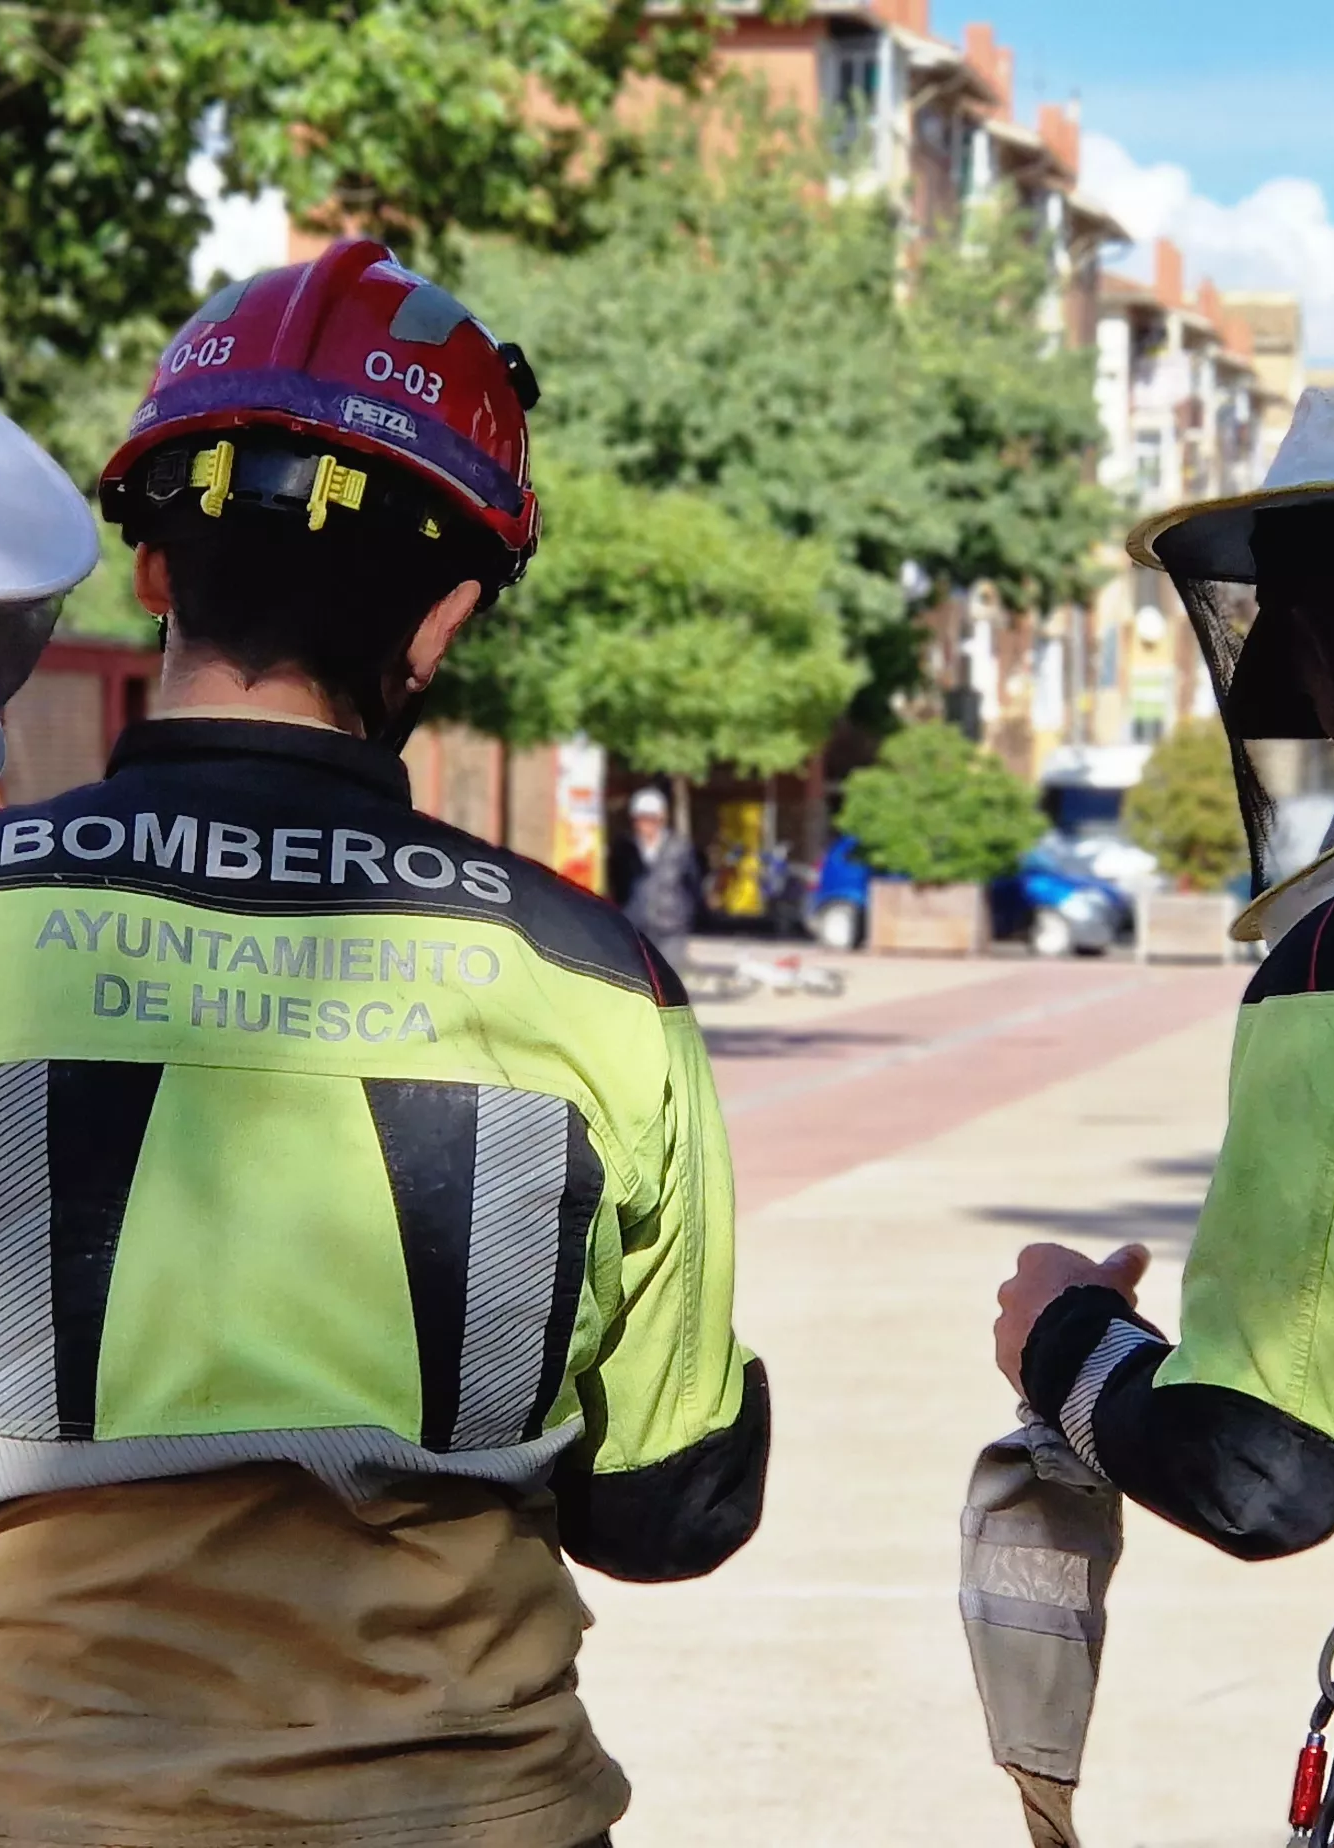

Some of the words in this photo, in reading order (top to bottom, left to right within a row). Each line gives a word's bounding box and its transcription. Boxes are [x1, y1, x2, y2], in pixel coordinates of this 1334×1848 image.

[169, 336, 235, 374] O-03
[365, 350, 443, 405] O-03
[343, 399, 417, 440] PETZL
[0, 812, 513, 904] BOMBEROS
[35, 908, 501, 986] AYUNTAMIENTO
[93, 973, 171, 1022] DE
[191, 984, 438, 1044] HUESCA
